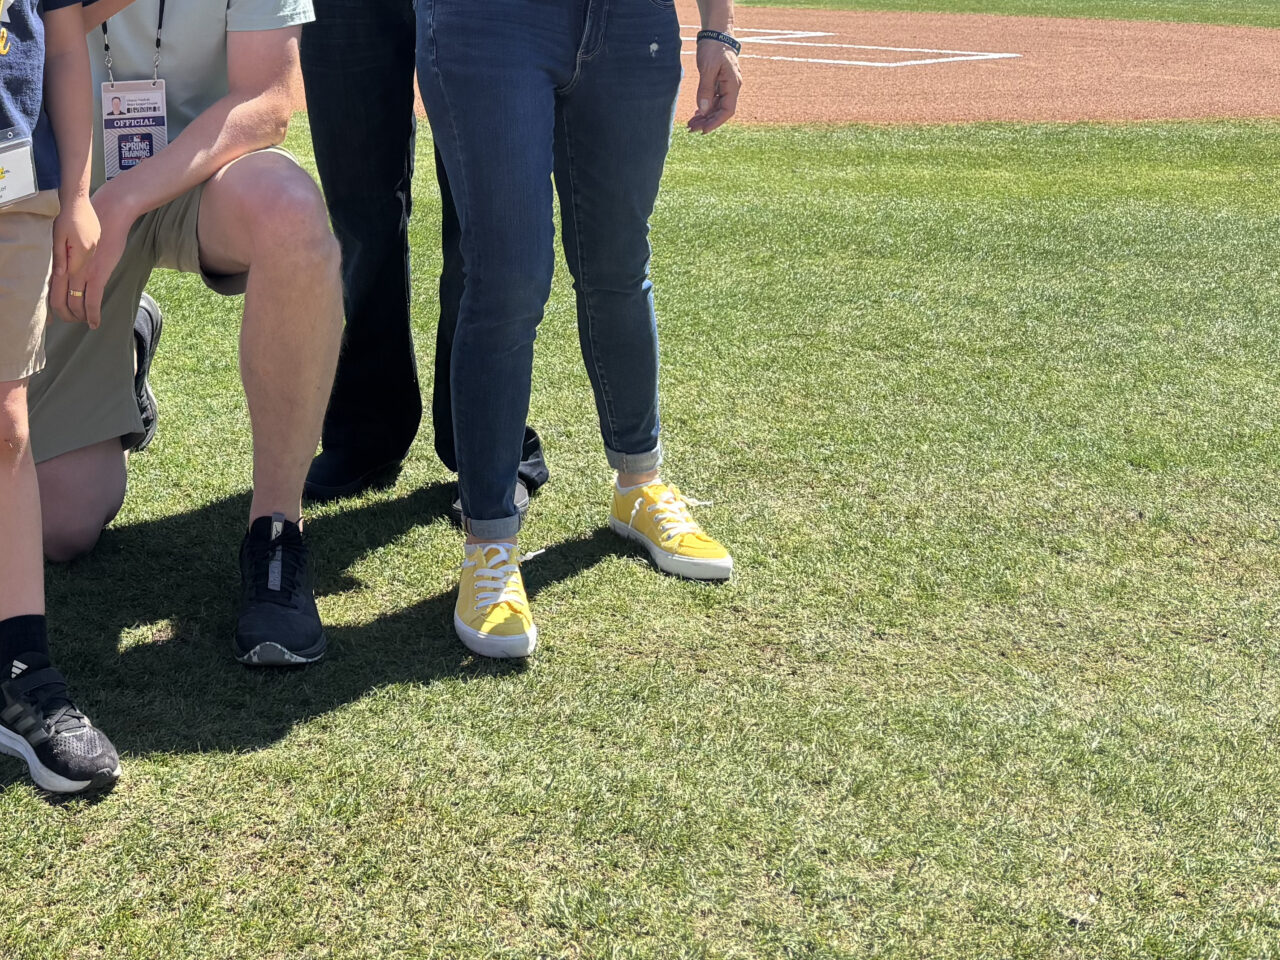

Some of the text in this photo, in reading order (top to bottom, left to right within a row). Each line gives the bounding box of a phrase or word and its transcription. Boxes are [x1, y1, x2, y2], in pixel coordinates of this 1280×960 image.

[114, 119, 156, 127] OFFICIAL
[121, 142, 150, 151] SPRING
[121, 149, 151, 158] TRAINING
